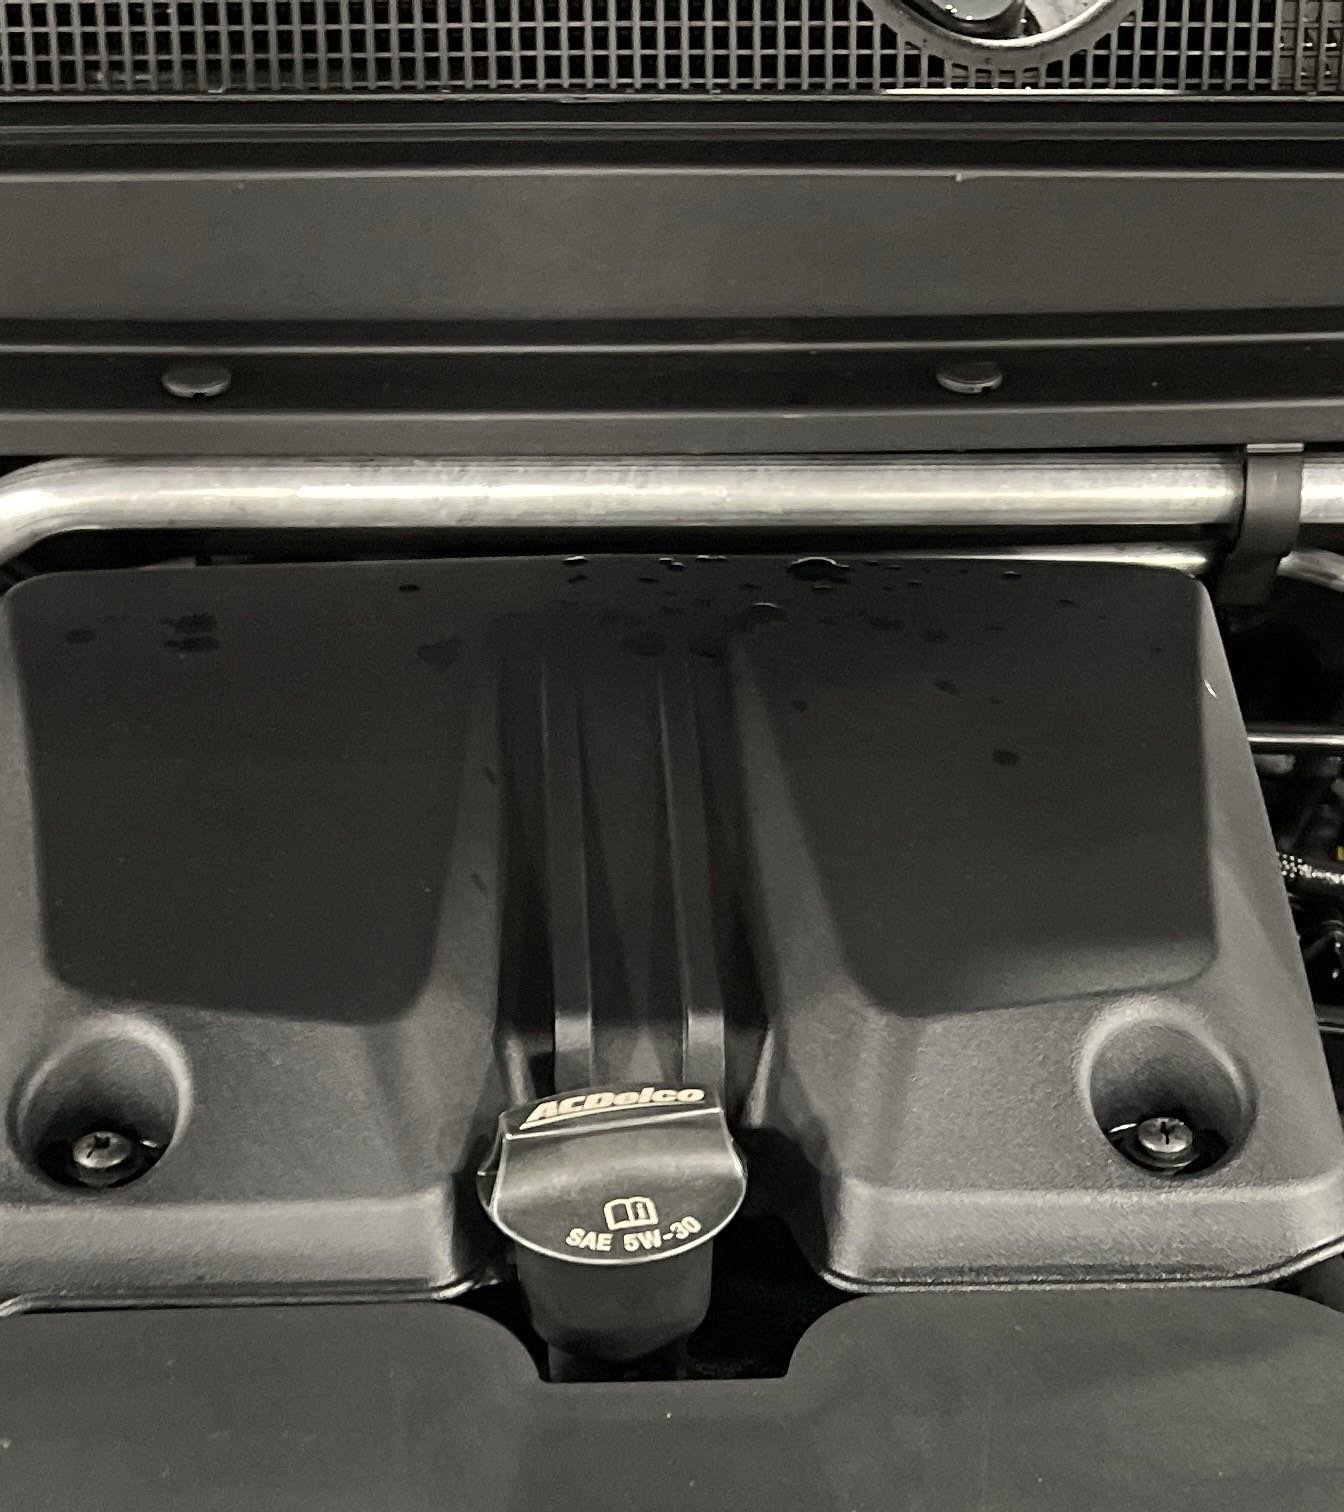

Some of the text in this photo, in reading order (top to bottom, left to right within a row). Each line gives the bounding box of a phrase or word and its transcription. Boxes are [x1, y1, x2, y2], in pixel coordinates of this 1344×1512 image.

[524, 1086, 705, 1123] ACDelco
[565, 1215, 702, 1252] SAE 5W-30
